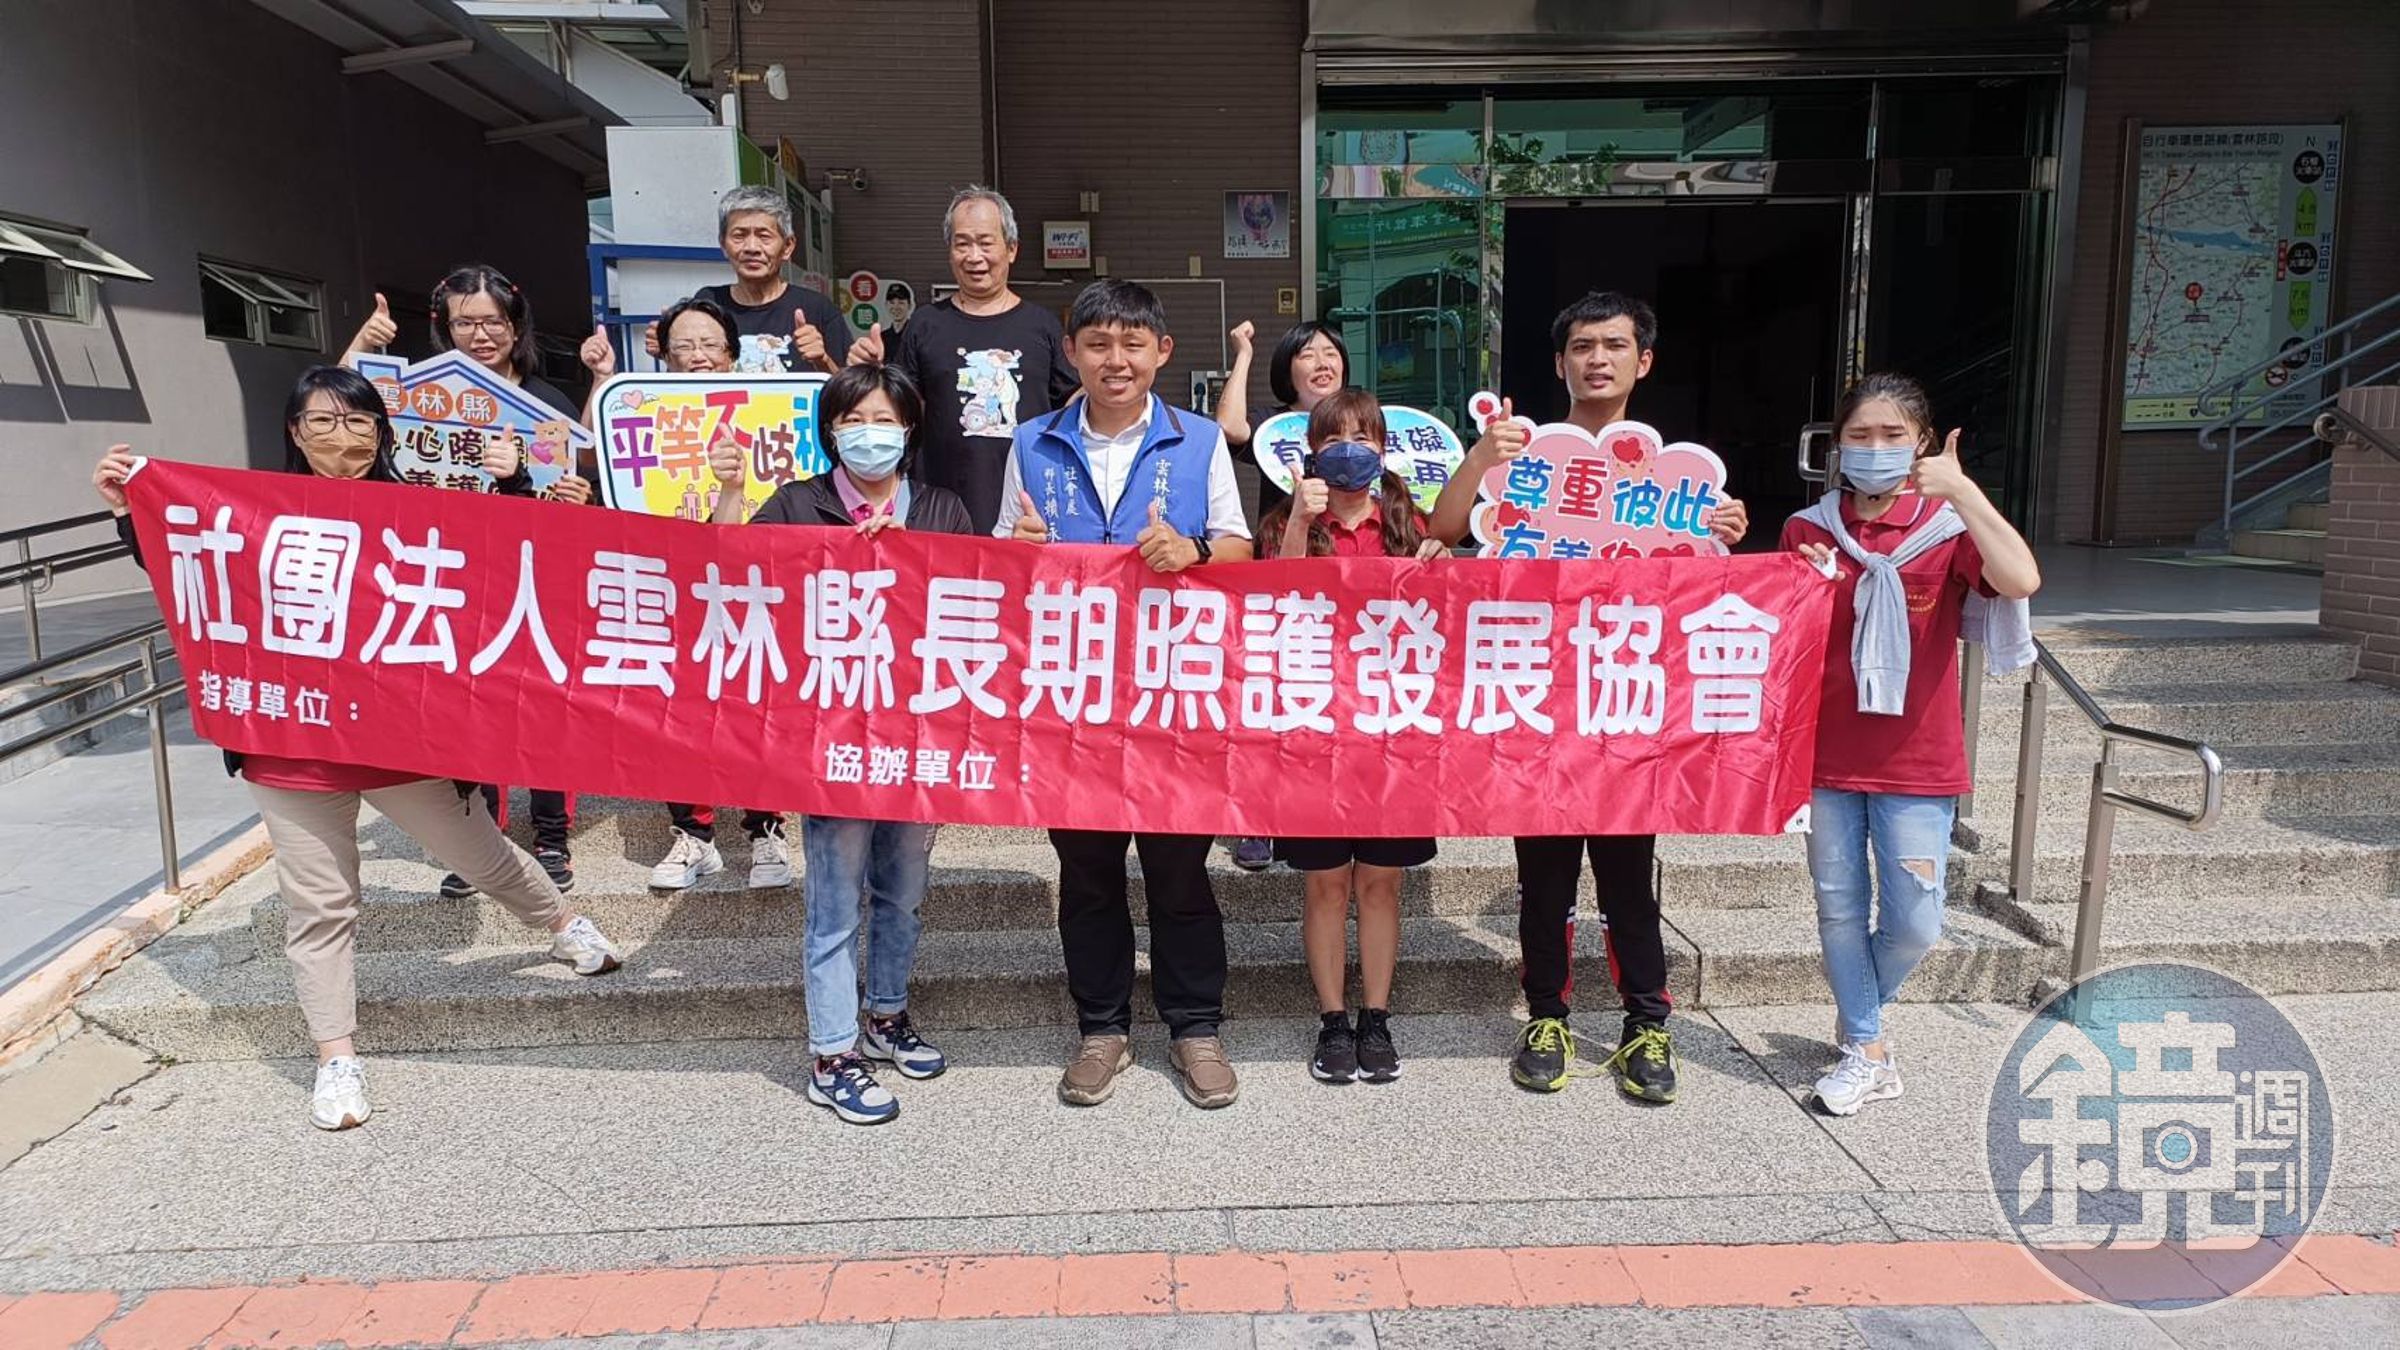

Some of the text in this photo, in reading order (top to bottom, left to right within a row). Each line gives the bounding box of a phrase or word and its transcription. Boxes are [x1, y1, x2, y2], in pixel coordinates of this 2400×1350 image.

[376, 383, 491, 422] 雲林縣
[1504, 456, 1718, 537] 尊重彼此
[164, 505, 1781, 738] 社團法人雲林縣長期照護發展協會
